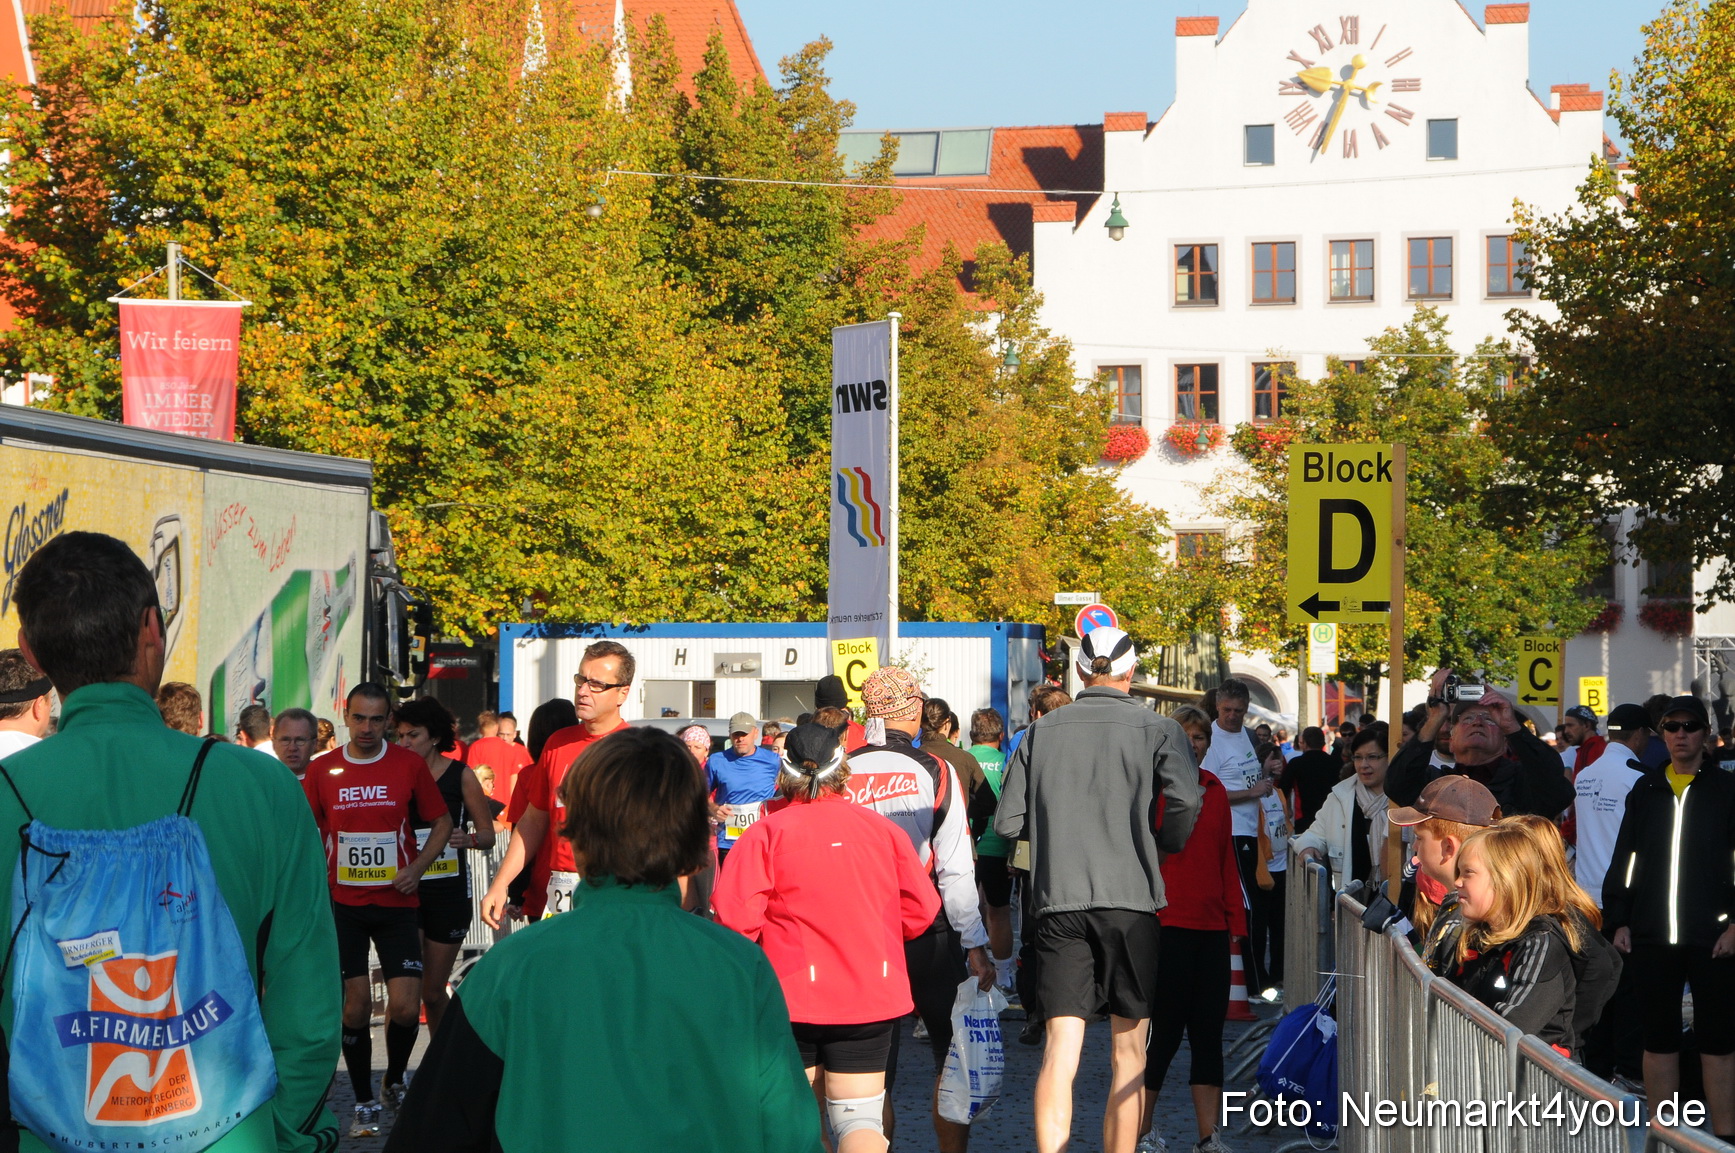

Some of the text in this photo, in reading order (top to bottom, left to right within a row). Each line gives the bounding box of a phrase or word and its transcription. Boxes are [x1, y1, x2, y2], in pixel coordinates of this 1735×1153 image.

[1339, 15, 1360, 45] XII
[126, 330, 232, 351] Wir feiern
[144, 393, 214, 409] IMMER
[141, 411, 215, 428] WIEDER
[1303, 452, 1393, 483] Block
[1318, 498, 1377, 584] D
[837, 642, 872, 656] Block
[1524, 640, 1560, 652] Block
[674, 648, 688, 666] H
[784, 648, 798, 666] D
[845, 659, 868, 692] C
[1528, 657, 1552, 692] C
[1588, 689, 1600, 707] B
[338, 786, 388, 802] REWE
[734, 813, 755, 827] 790
[348, 846, 385, 867] 650
[348, 868, 386, 879] Markus
[169, 1074, 187, 1086] DER
[151, 1116, 231, 1148] SCHWARZ
[61, 1136, 130, 1149] HUBERT
